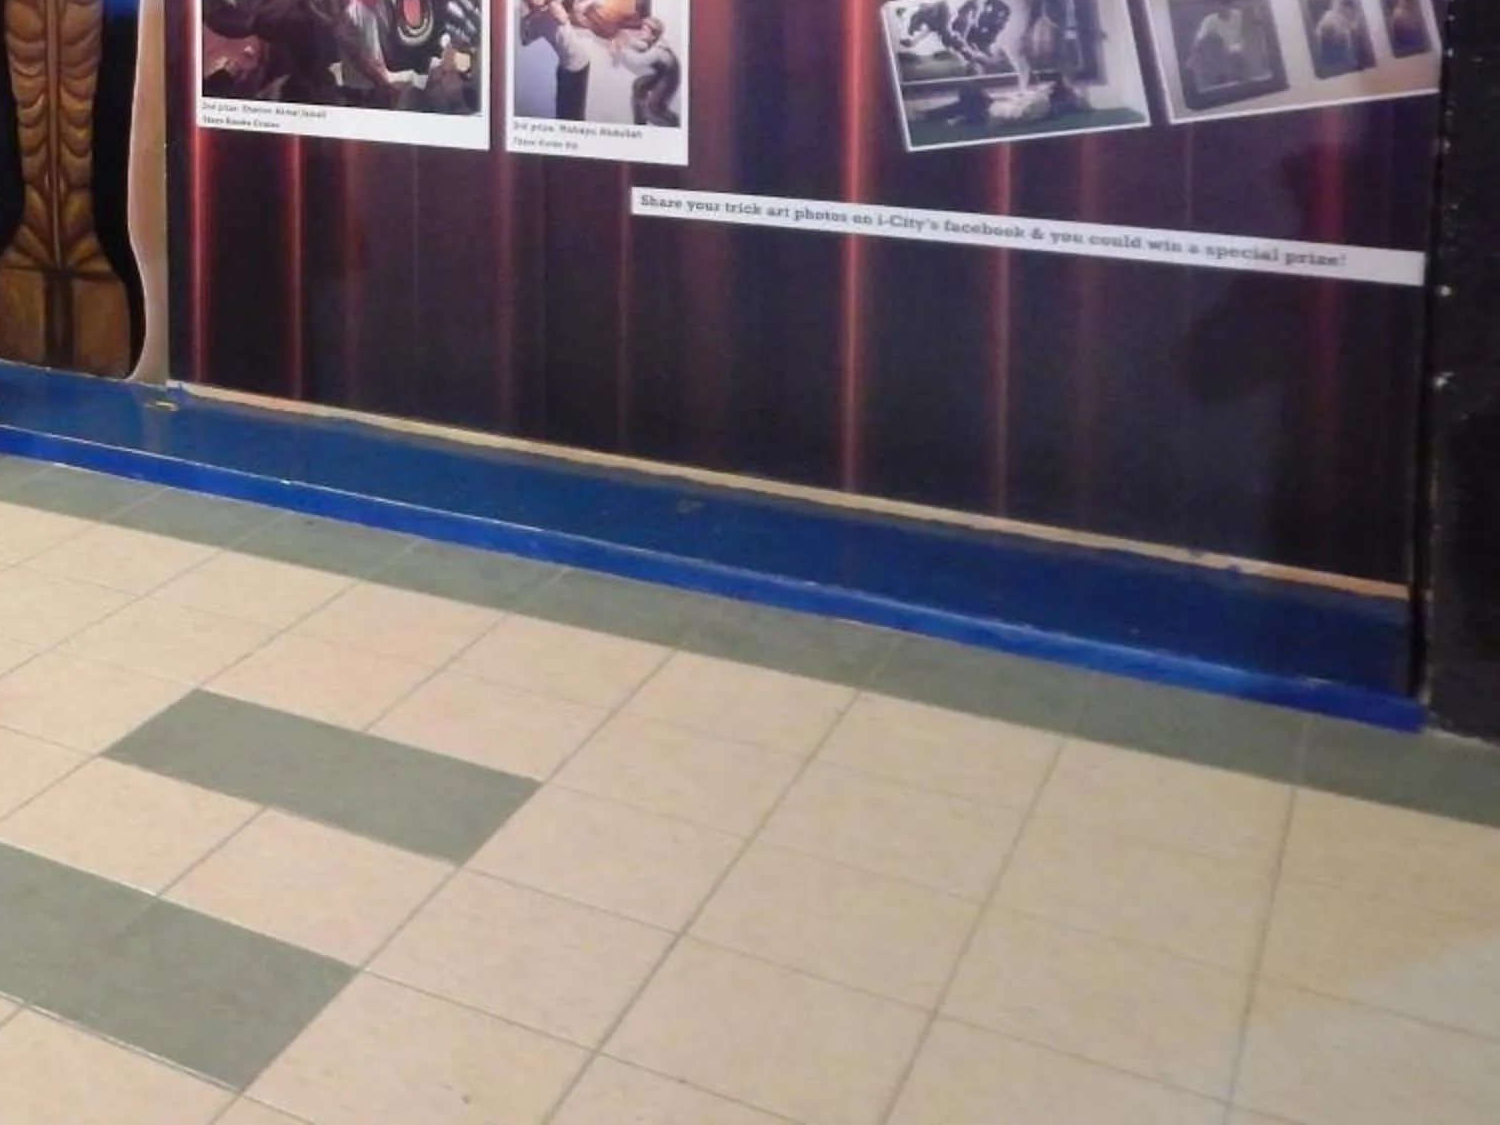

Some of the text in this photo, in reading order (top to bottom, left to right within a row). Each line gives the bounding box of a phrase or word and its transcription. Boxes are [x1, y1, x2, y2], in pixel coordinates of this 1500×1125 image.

[640, 194, 683, 209] Share
[686, 198, 720, 213] your
[725, 201, 761, 216] trick
[767, 206, 790, 218] art
[795, 208, 847, 224] photos
[853, 215, 873, 225] on
[878, 213, 939, 231] i-City's
[944, 218, 1025, 238] facebook
[1031, 228, 1044, 240] &
[1051, 232, 1083, 247] you
[1089, 235, 1141, 250] could
[1148, 238, 1183, 253] win
[1188, 245, 1199, 255] a
[1204, 244, 1279, 262] special
